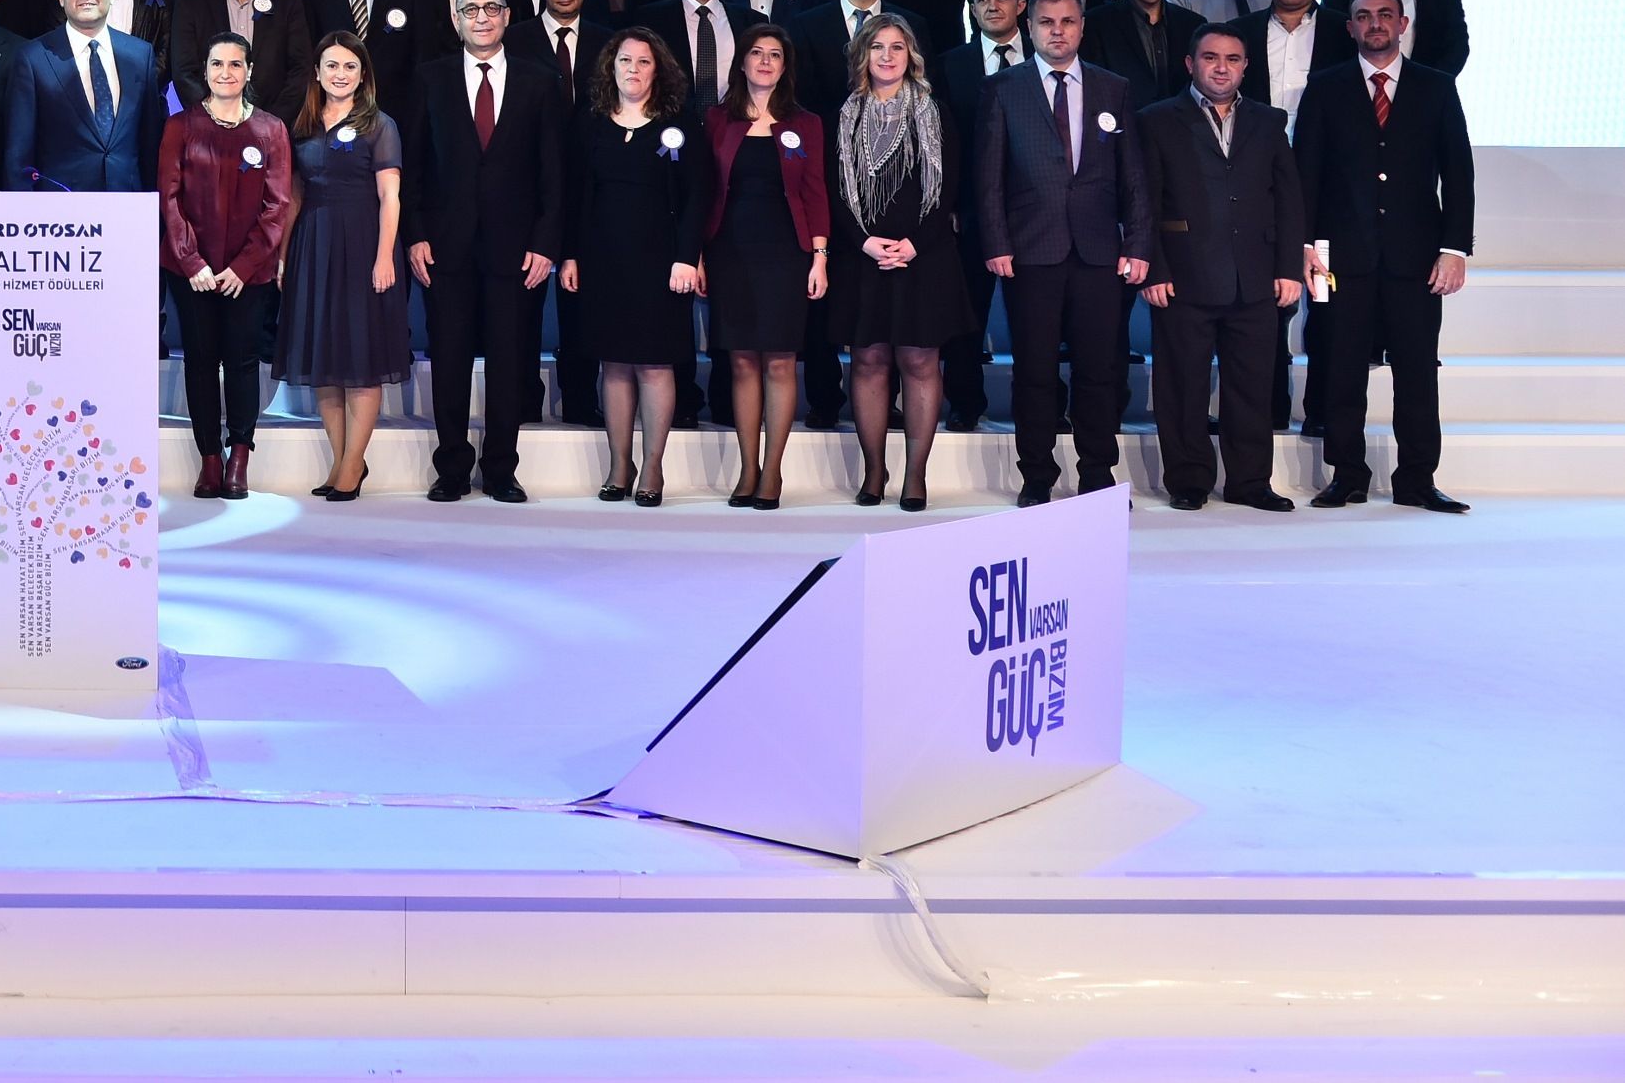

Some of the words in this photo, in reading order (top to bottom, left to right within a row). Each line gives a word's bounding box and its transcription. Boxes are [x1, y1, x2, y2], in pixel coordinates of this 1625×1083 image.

[24, 223, 102, 238] OTOSAN
[81, 245, 102, 272] İZ
[3, 278, 45, 290] HİZMET
[48, 278, 104, 290] ÖDÜLLERİ
[2, 309, 34, 331] SEN
[36, 322, 61, 331] VARSAN
[13, 333, 47, 361] GÜÇ
[49, 333, 61, 357] BİZİM
[41, 428, 62, 447] BİZİM
[22, 445, 43, 482] GELECEK
[15, 483, 26, 517] VARSAN
[37, 525, 49, 542] SEN
[79, 451, 101, 469] BİZİM
[17, 519, 27, 537] SEN
[0, 539, 19, 556] BİZİM
[18, 539, 26, 562] BİZİM
[35, 544, 43, 567] BİZİM
[968, 557, 1028, 656] SEN
[1029, 598, 1069, 640] VARSAN
[1047, 638, 1068, 732] BİZİM
[986, 647, 1046, 757] GÜÇ
